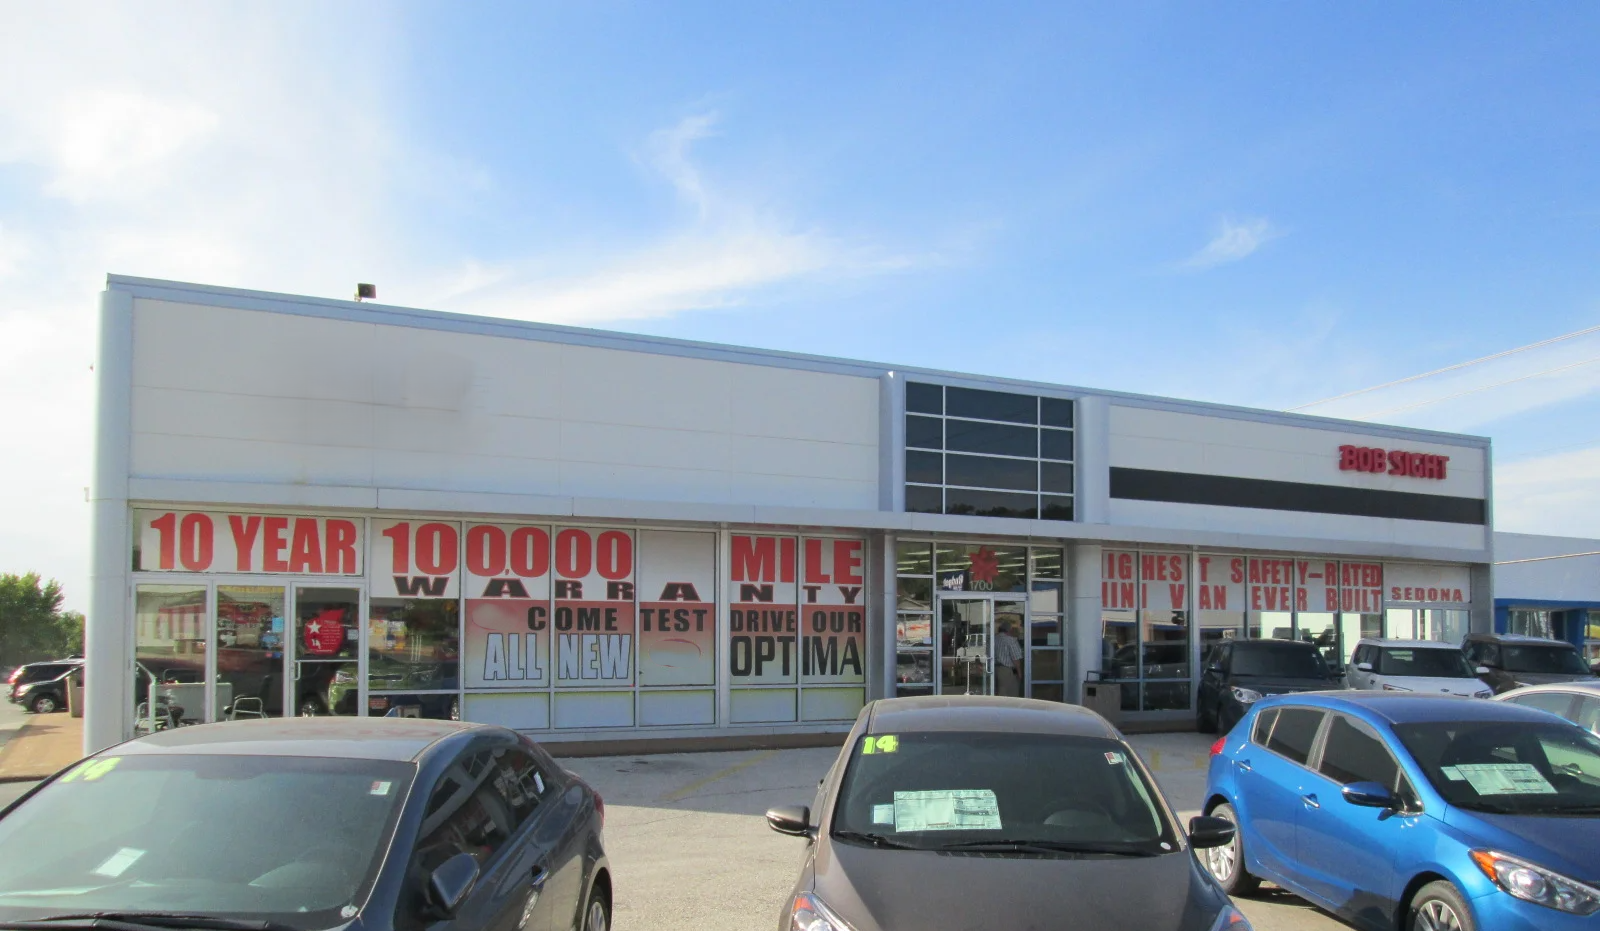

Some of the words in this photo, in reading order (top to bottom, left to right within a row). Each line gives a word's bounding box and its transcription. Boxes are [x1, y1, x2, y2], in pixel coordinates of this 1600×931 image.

[1339, 445, 1386, 473] BOB
[1388, 451, 1450, 480] SIGHT
[150, 512, 214, 572] 10
[228, 515, 356, 574] YEAR
[382, 521, 632, 579] 100,000
[731, 535, 863, 585] MILE
[1102, 552, 1210, 582] IGHEST
[392, 576, 861, 604] WARRANTY
[1169, 583, 1226, 610] VAN
[1252, 586, 1308, 611] EVER
[1326, 587, 1382, 613] BUILT
[1391, 586, 1464, 602] SEDONA
[527, 606, 618, 631] COME
[640, 608, 708, 632] TEST
[731, 610, 796, 632] DRIVE
[812, 611, 862, 633] OUR
[483, 632, 542, 680] ALL
[558, 633, 632, 680] NEW
[730, 635, 863, 677] OPTIMA
[862, 735, 898, 755] 14
